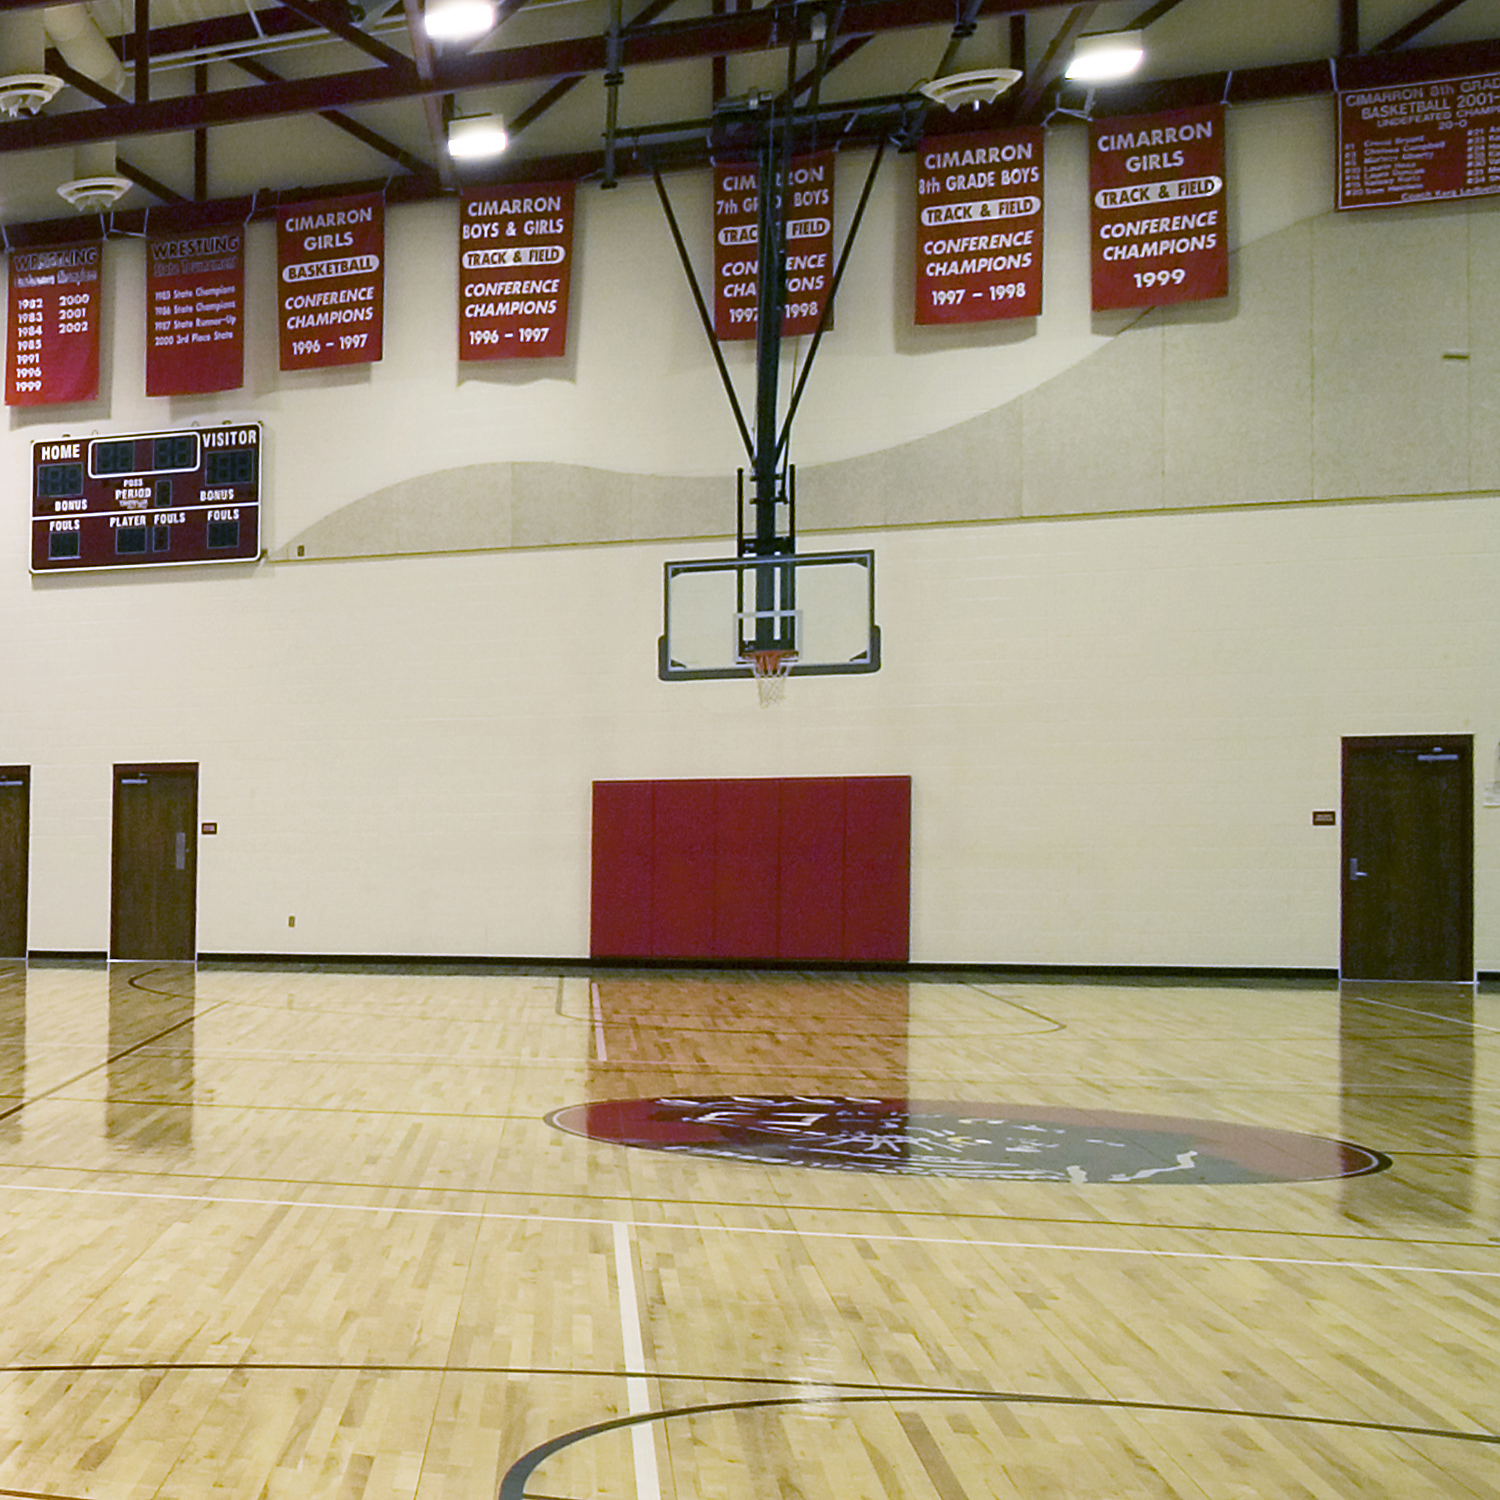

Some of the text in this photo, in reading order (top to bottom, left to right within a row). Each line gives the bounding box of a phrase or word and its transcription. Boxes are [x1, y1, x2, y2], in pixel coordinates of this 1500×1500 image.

[1345, 88, 1423, 107] CIMARRON
[1361, 98, 1451, 120] BASKETBALL
[1377, 111, 1452, 128] UNDEFEATED
[1097, 121, 1213, 152] CIMARRON
[924, 143, 1033, 170] CIMARRON
[1125, 150, 1185, 173] GIRLS
[723, 166, 824, 191] CIMON
[918, 166, 1040, 195] 8th GRADE BOYS
[716, 198, 738, 215] 7th
[794, 188, 829, 207] BOYS
[1101, 179, 1214, 206] TRACK & FIELD
[467, 196, 561, 217] CIMARRON
[926, 199, 1033, 223] TRACK & FIELD
[285, 207, 373, 232] CIMARRON
[462, 218, 564, 240] BOYS & GIRLS
[1100, 210, 1218, 239] CONFERENCE
[723, 220, 825, 243] TRAC FIELD
[152, 235, 239, 260] WRESTLING
[303, 232, 353, 251] GIRLS
[923, 230, 1034, 255] CONFERENCE
[1103, 233, 1217, 261] CHAMPIONS
[467, 247, 560, 266] TRACK & FIELD
[722, 253, 827, 277] CONENCE
[925, 252, 1033, 277] CHAMPIONS
[288, 257, 373, 280] BASKETBALL
[464, 279, 560, 298] CONFERENCE
[723, 275, 825, 298] CHAONS
[1133, 269, 1186, 289] 1999
[58, 294, 90, 306] 2000
[173, 289, 193, 299] State
[196, 284, 236, 297] Champions
[284, 286, 375, 310] CONFERENCE
[931, 288, 966, 306] 1997
[989, 282, 1026, 300] 1998
[18, 298, 43, 310] 1982
[58, 307, 86, 320] 2001
[174, 304, 193, 314] State
[196, 300, 236, 313] Champions
[464, 300, 557, 318] CHAMPIONS
[784, 301, 818, 319] 1998
[18, 312, 43, 324] 1983
[58, 321, 88, 334] 2002
[173, 319, 193, 330] State
[196, 314, 237, 328] Runner-Up
[286, 307, 374, 330] CHAMPIONS
[17, 325, 42, 337] 1984
[154, 331, 233, 346] 2000 3rd Place State
[469, 329, 499, 345] 1996
[518, 327, 550, 343] 1997
[17, 339, 42, 351] 1985
[291, 339, 321, 355] 1996
[339, 334, 368, 350] 1997
[16, 353, 40, 365] 1991
[16, 367, 42, 379] 1996
[15, 380, 42, 392] 1999
[203, 430, 257, 448] VISITOR
[41, 444, 80, 461] HOME
[115, 487, 151, 500] PERIOD
[200, 489, 234, 501] BONUS
[55, 499, 88, 512] BONUS
[207, 509, 239, 521] FOULS
[50, 519, 80, 531] FOULS
[109, 512, 186, 528] PLAYER FOULS
